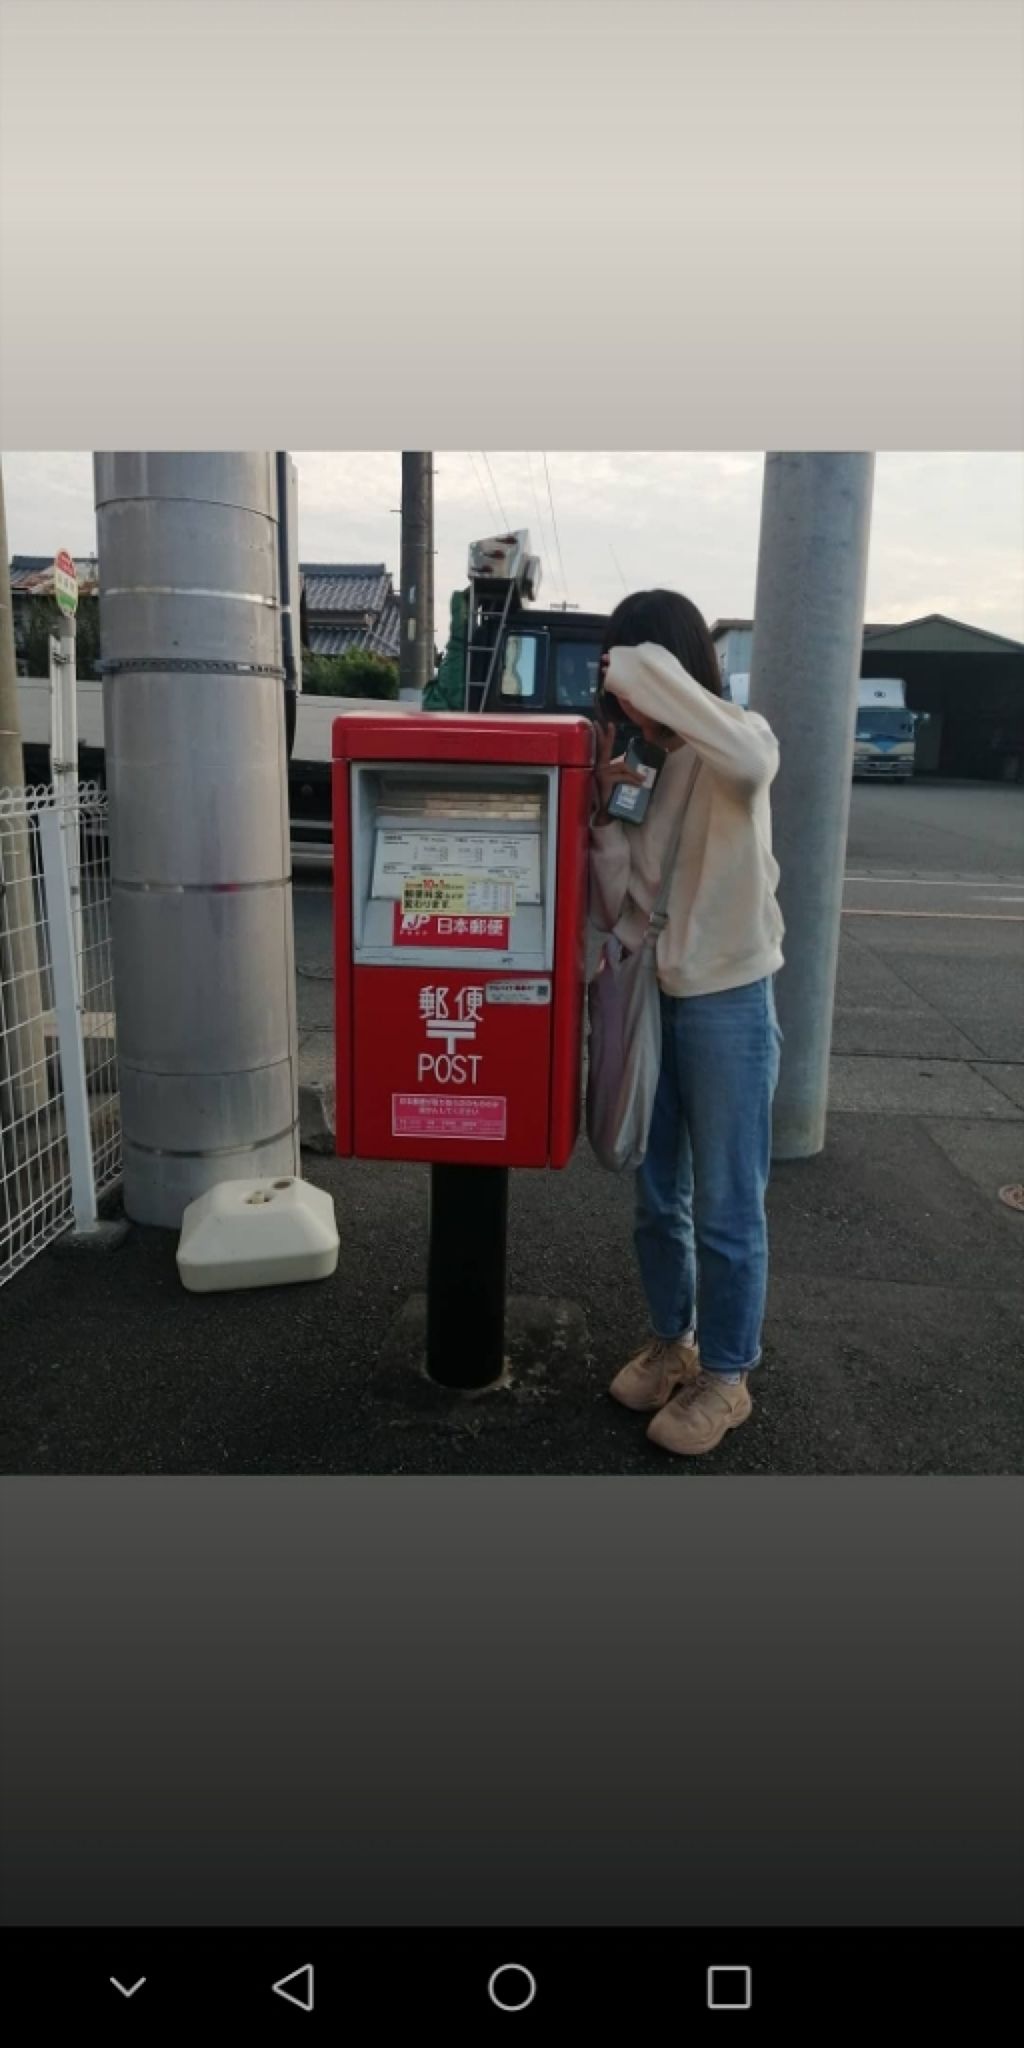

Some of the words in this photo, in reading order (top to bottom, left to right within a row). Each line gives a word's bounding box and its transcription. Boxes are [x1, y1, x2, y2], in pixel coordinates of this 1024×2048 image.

[437, 917, 504, 936] 日本郵便
[419, 985, 485, 1022] 郵便
[417, 1053, 483, 1085] POST
